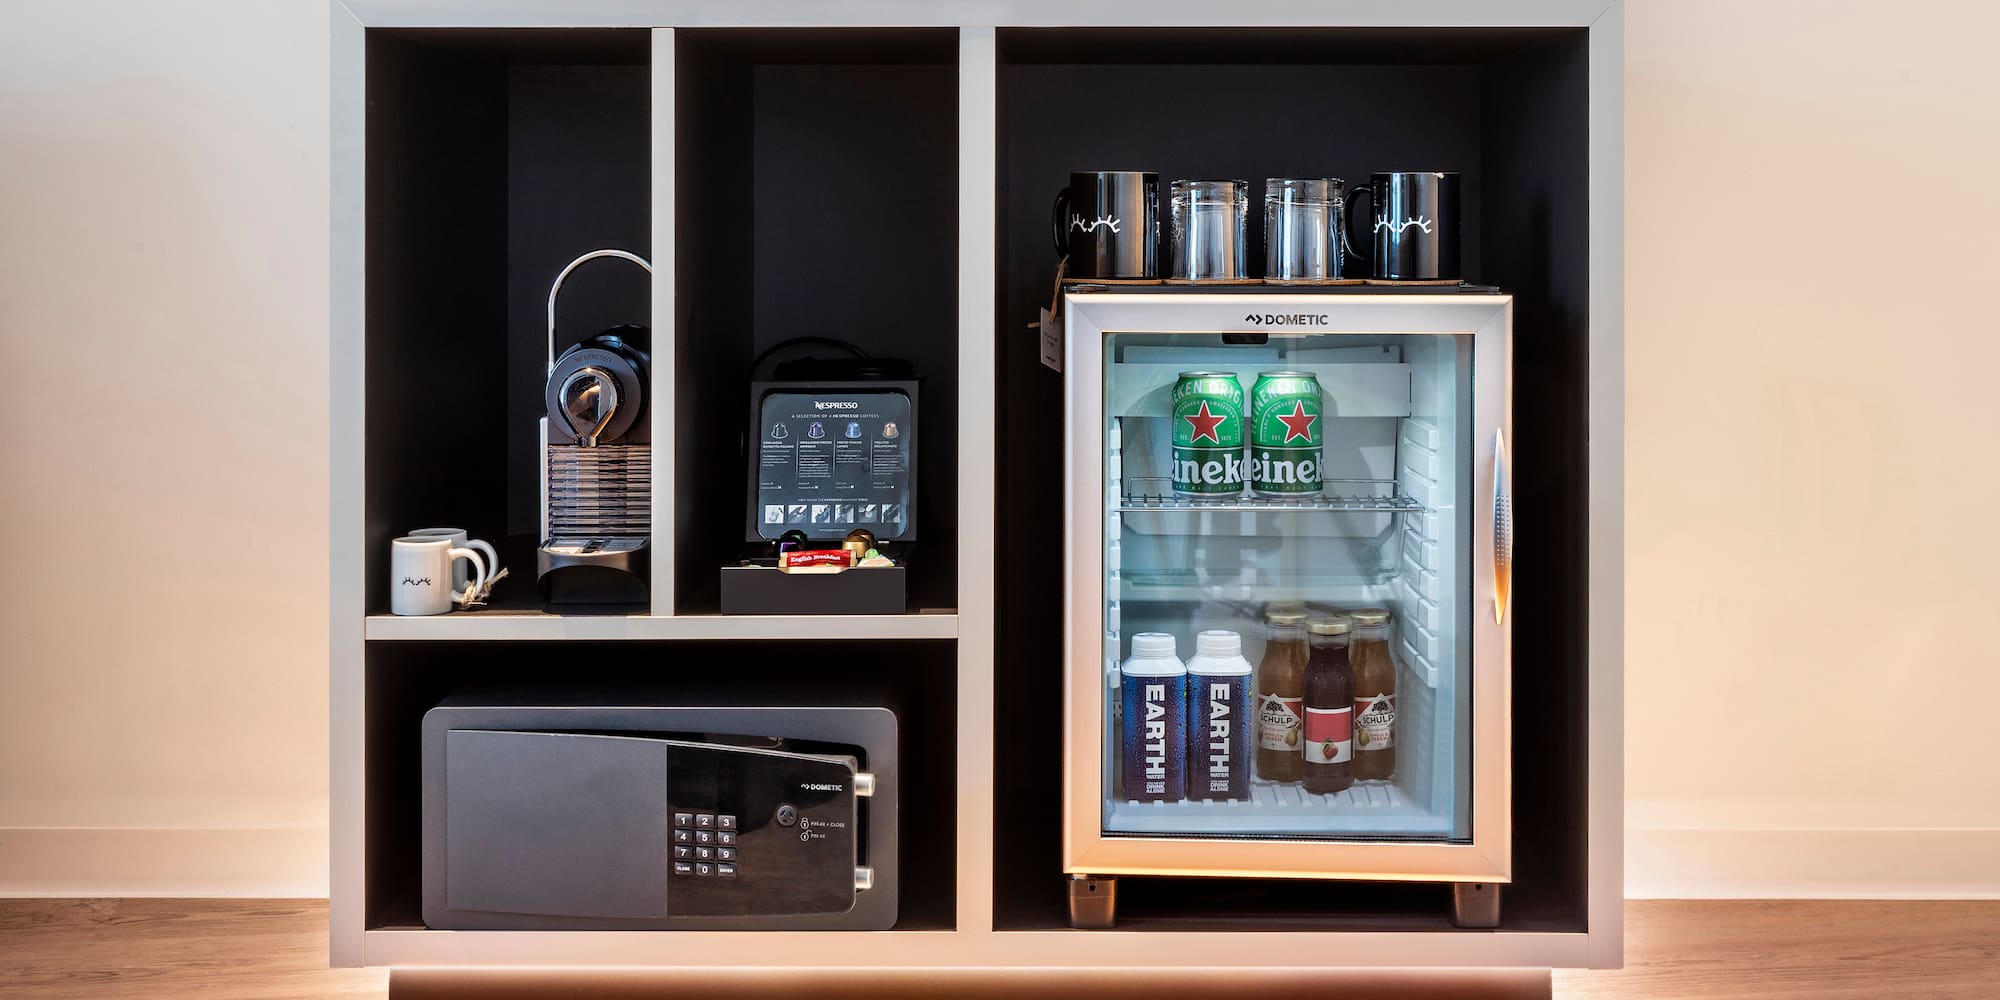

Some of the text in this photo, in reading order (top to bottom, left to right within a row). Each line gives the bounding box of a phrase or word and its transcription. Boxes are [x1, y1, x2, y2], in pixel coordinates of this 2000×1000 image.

[1265, 314, 1328, 325] DOMETIC
[814, 401, 858, 410] NESPRESSO
[1260, 713, 1293, 724] SCHULP
[1362, 714, 1394, 724] SCHULP
[1145, 684, 1165, 775] EARTH
[1209, 683, 1230, 773] EARTH
[723, 835, 730, 843] 6
